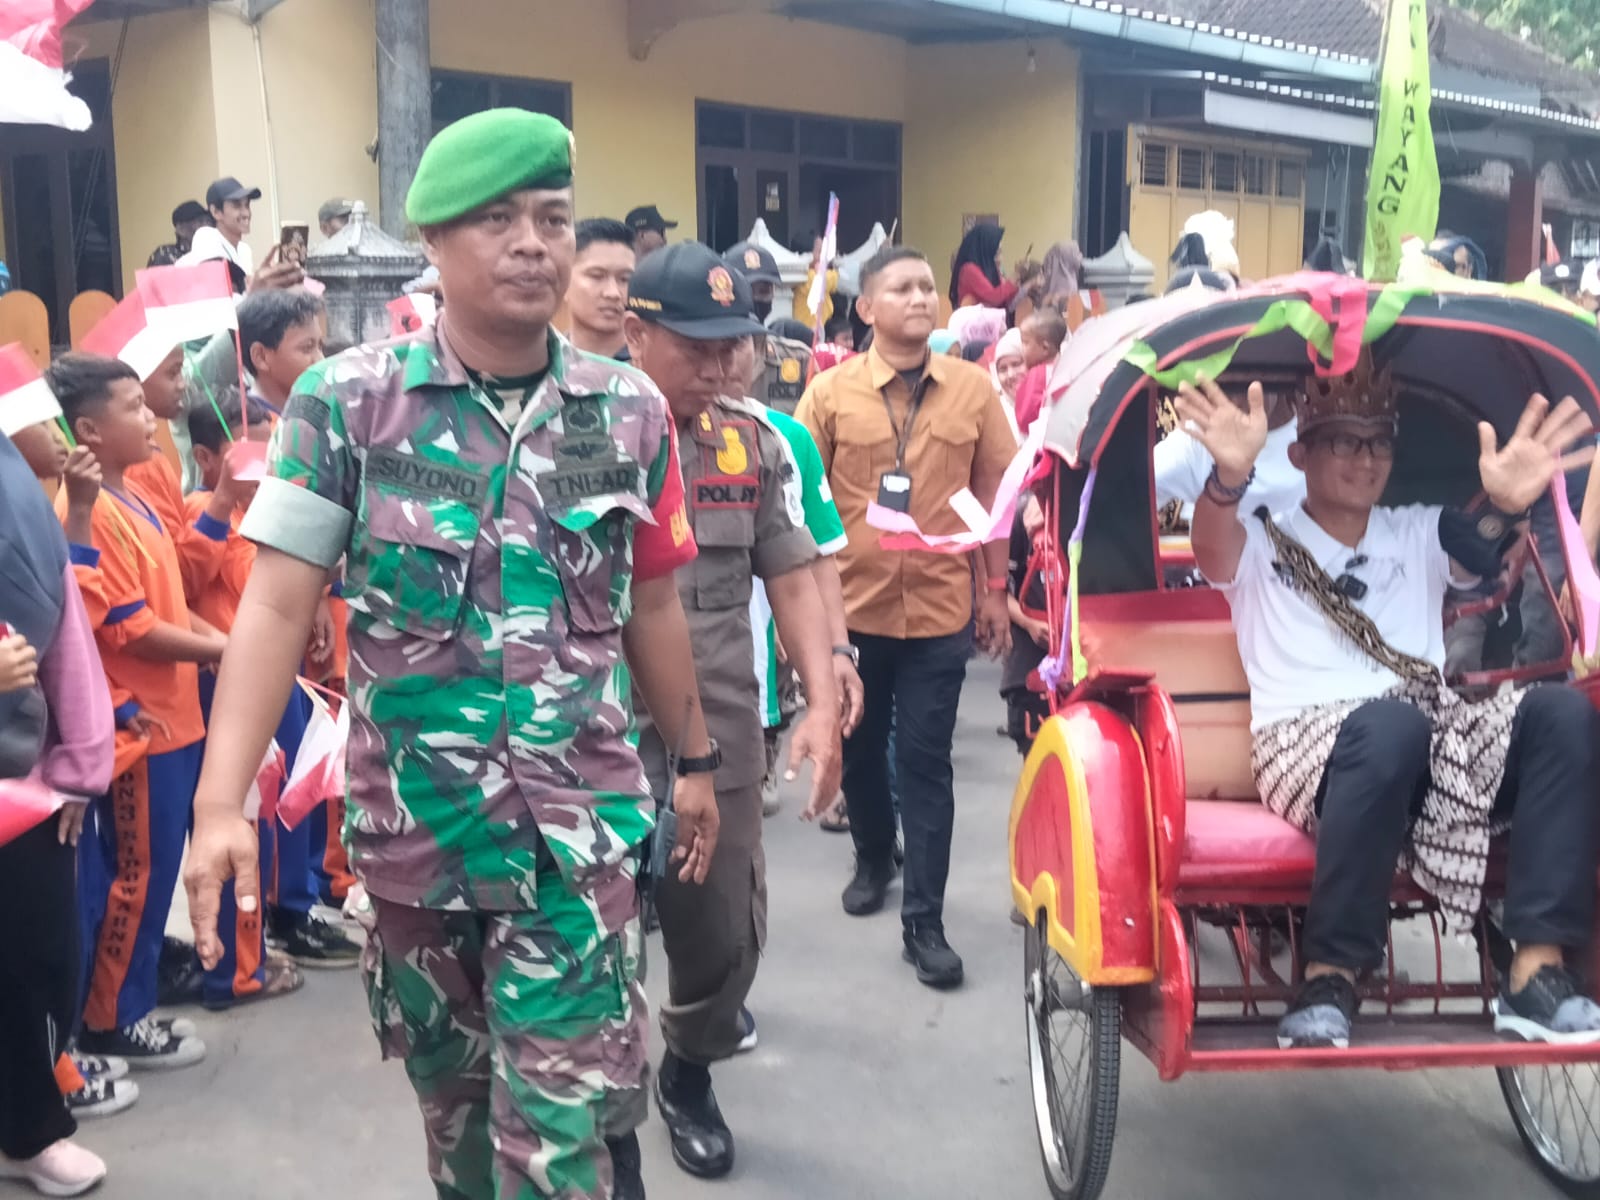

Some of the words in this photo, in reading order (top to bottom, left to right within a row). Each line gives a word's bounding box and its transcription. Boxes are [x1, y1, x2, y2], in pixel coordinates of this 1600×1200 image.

[1377, 79, 1420, 216] WAYANG
[378, 456, 478, 499] SUYONO
[550, 467, 630, 498] TNI-AD
[697, 484, 737, 503] POL
